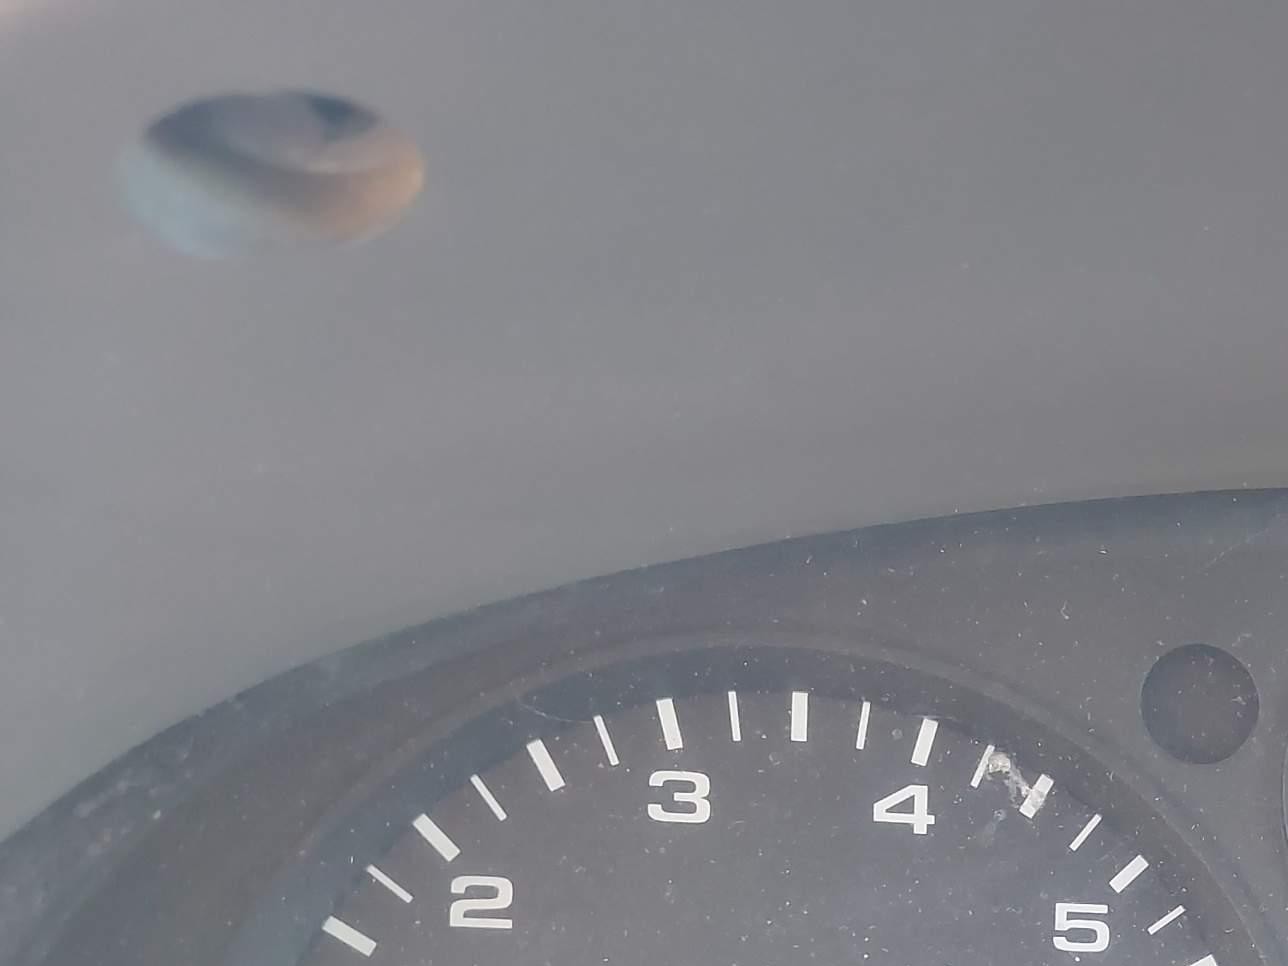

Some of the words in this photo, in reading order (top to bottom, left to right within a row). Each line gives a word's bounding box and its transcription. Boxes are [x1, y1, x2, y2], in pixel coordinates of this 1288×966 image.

[648, 770, 711, 824] 3
[873, 784, 935, 835] 4
[449, 875, 513, 929] 2
[1053, 902, 1110, 952] 5
